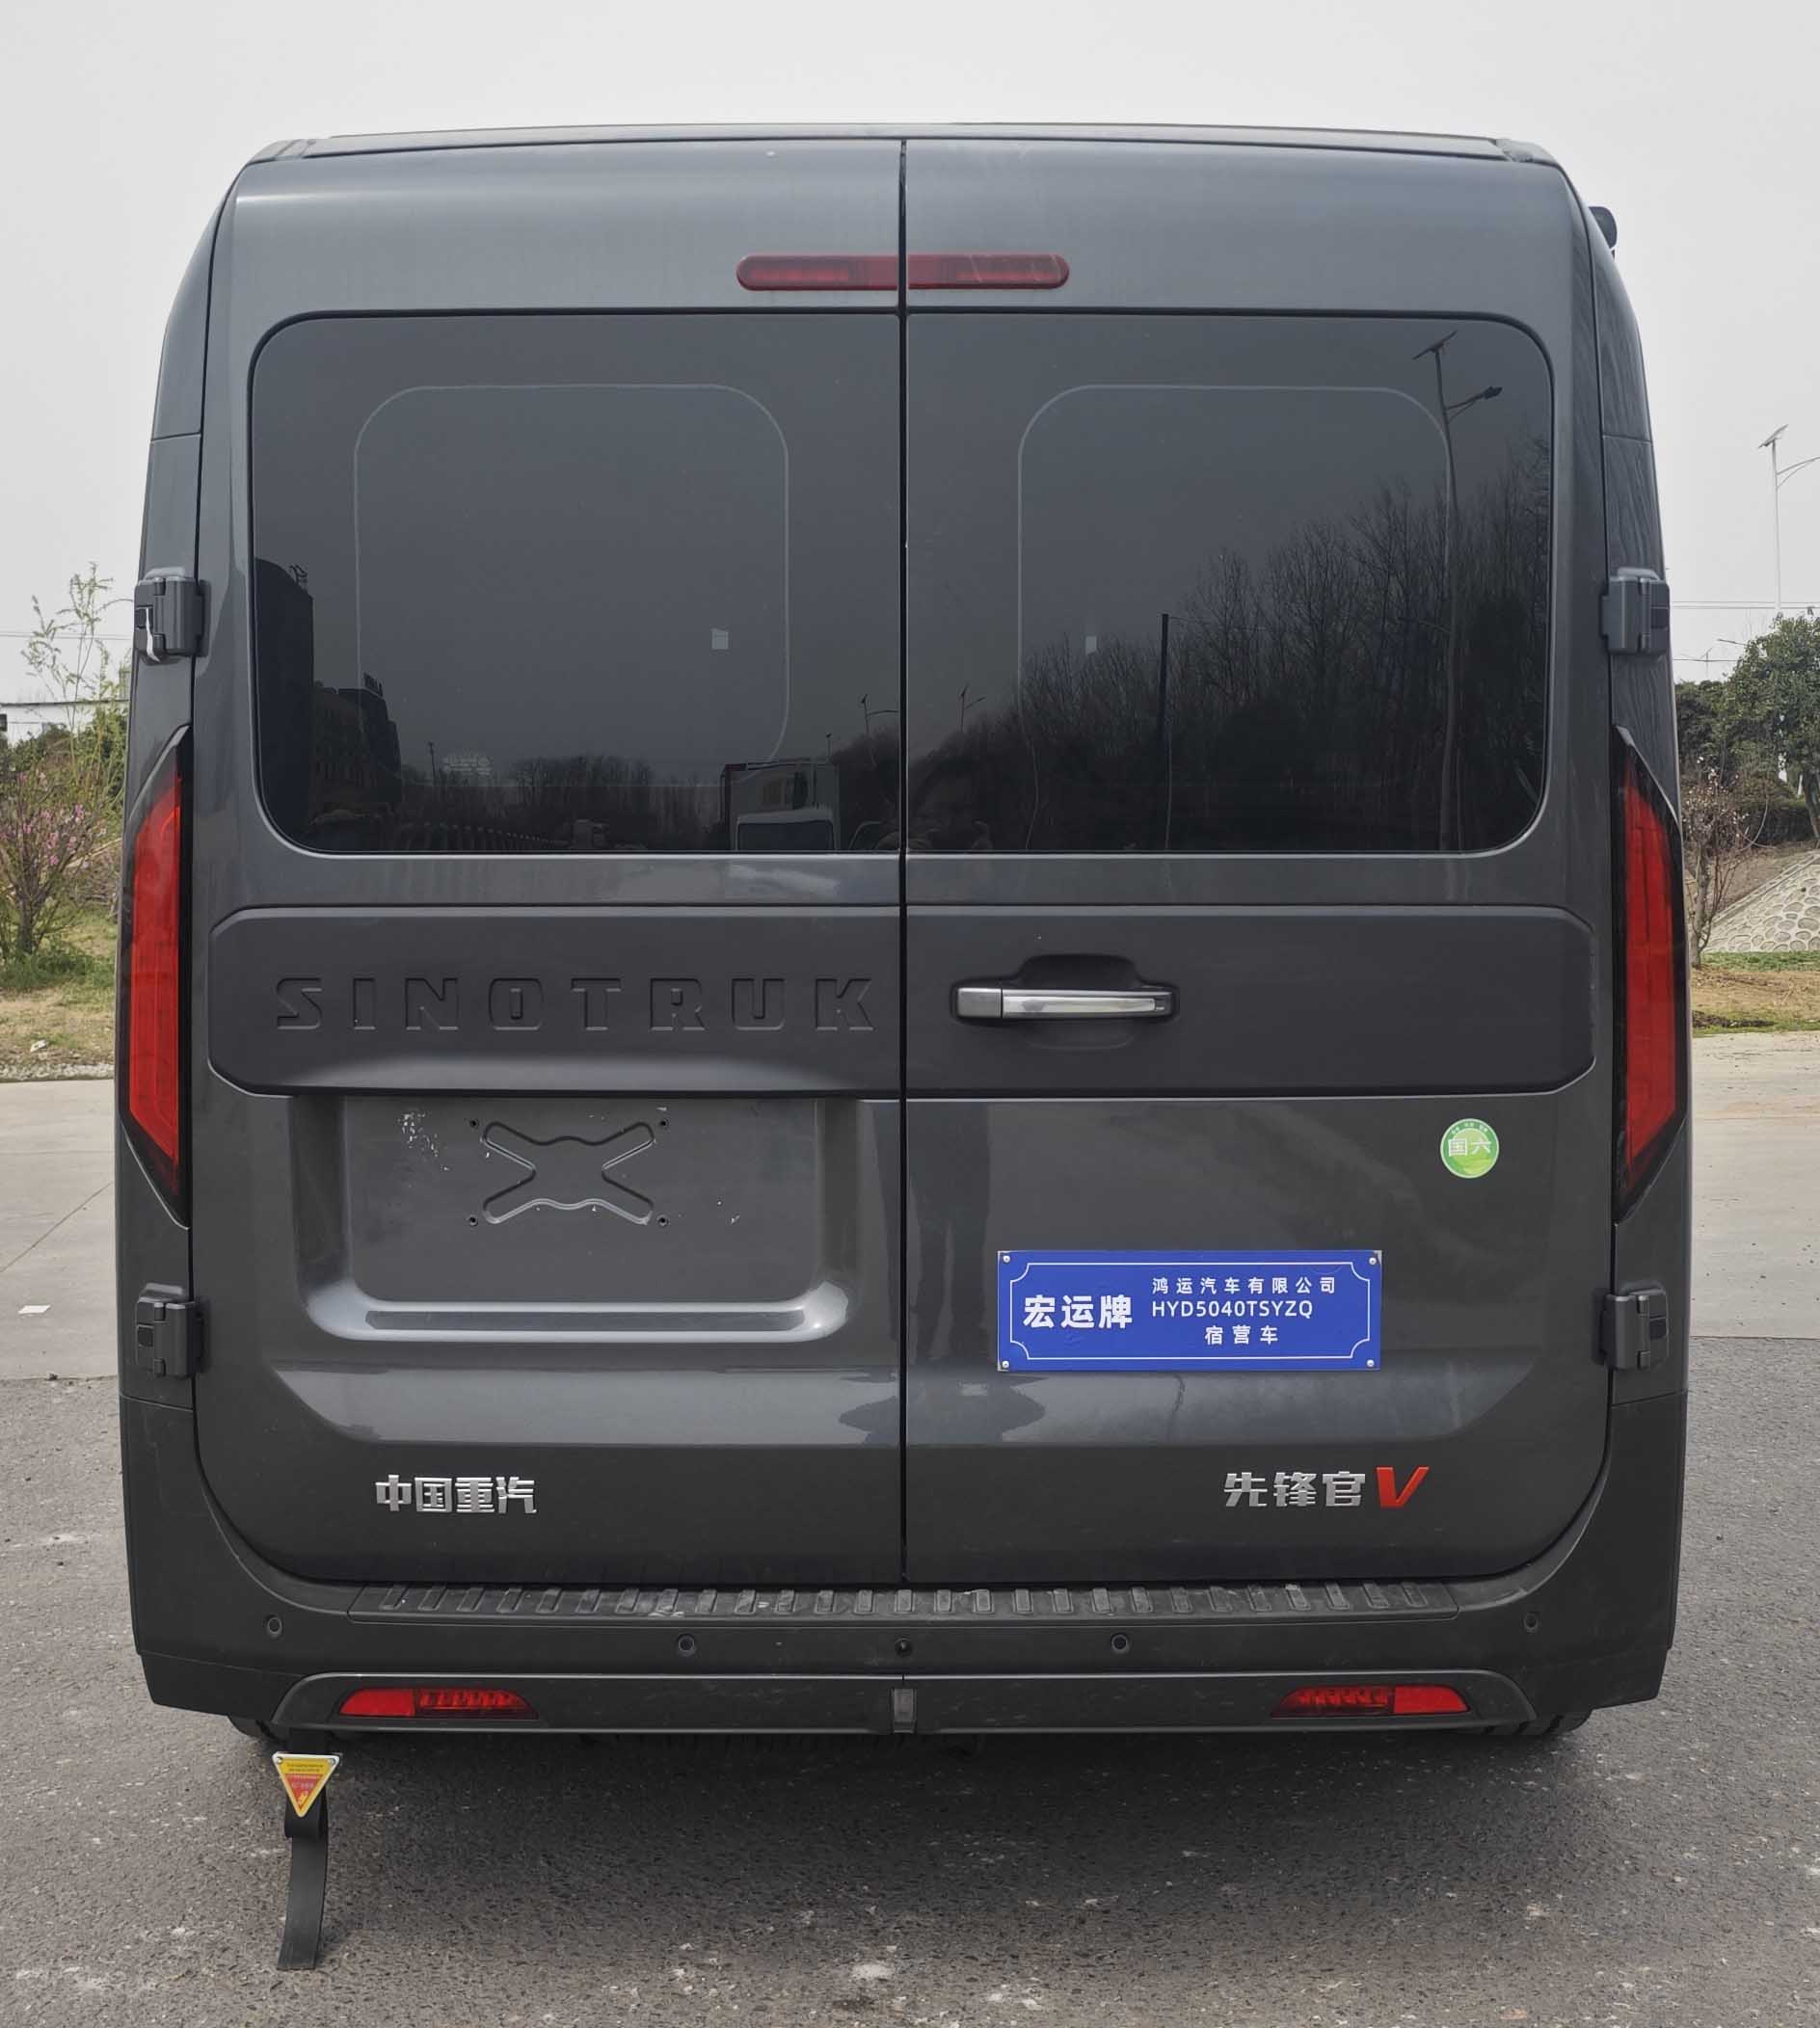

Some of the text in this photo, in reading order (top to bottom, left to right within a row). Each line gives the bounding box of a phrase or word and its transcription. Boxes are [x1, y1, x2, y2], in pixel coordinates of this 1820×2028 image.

[276, 977, 872, 1030] SINOTRUK
[1152, 1277, 1336, 1294] 鸿运汽车有限公司
[1023, 1294, 1133, 1328] 宏运牌
[1152, 1300, 1314, 1319] HYD5040TSYZQ
[1204, 1325, 1278, 1345] 宿营车
[375, 1474, 537, 1513] 中国重汽
[1223, 1471, 1366, 1508] 先锋官
